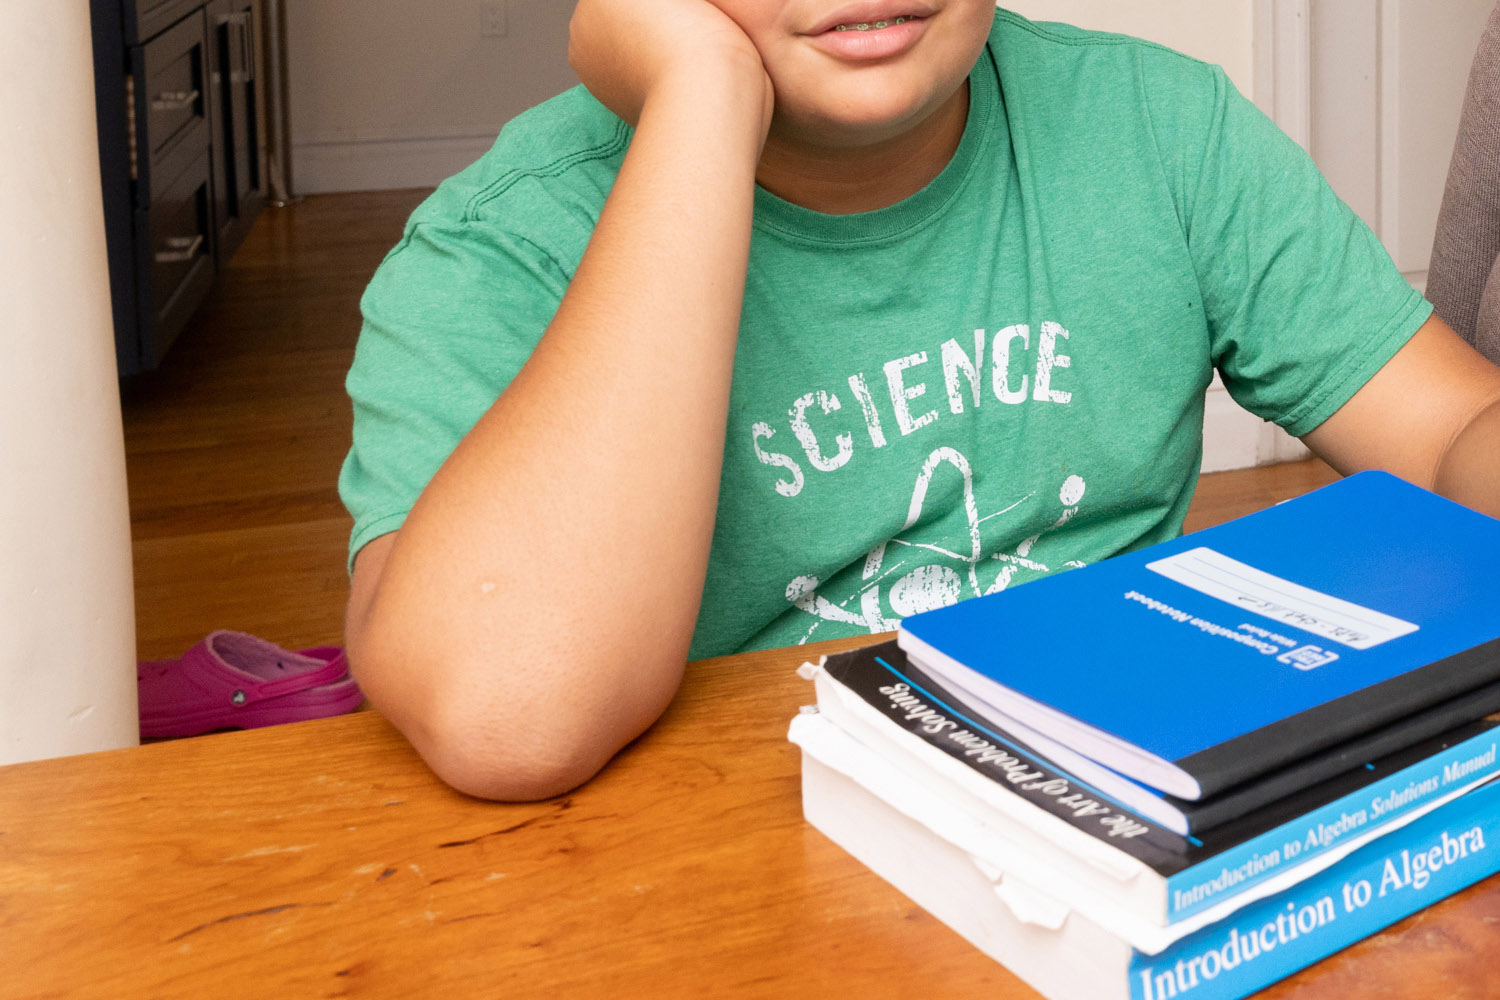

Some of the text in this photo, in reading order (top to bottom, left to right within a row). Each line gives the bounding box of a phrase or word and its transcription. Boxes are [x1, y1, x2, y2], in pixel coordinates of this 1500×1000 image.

[752, 320, 1072, 498] SCIENCE
[1124, 590, 1279, 655] Composition Notebook
[878, 682, 958, 734] Solving
[948, 729, 1030, 785] Problem
[1022, 771, 1069, 797] of
[1057, 794, 1110, 818] Art
[1173, 743, 1497, 912] Introduction to Algebra Solutions Manual
[1140, 826, 1486, 1000] Introduction to Algebra
